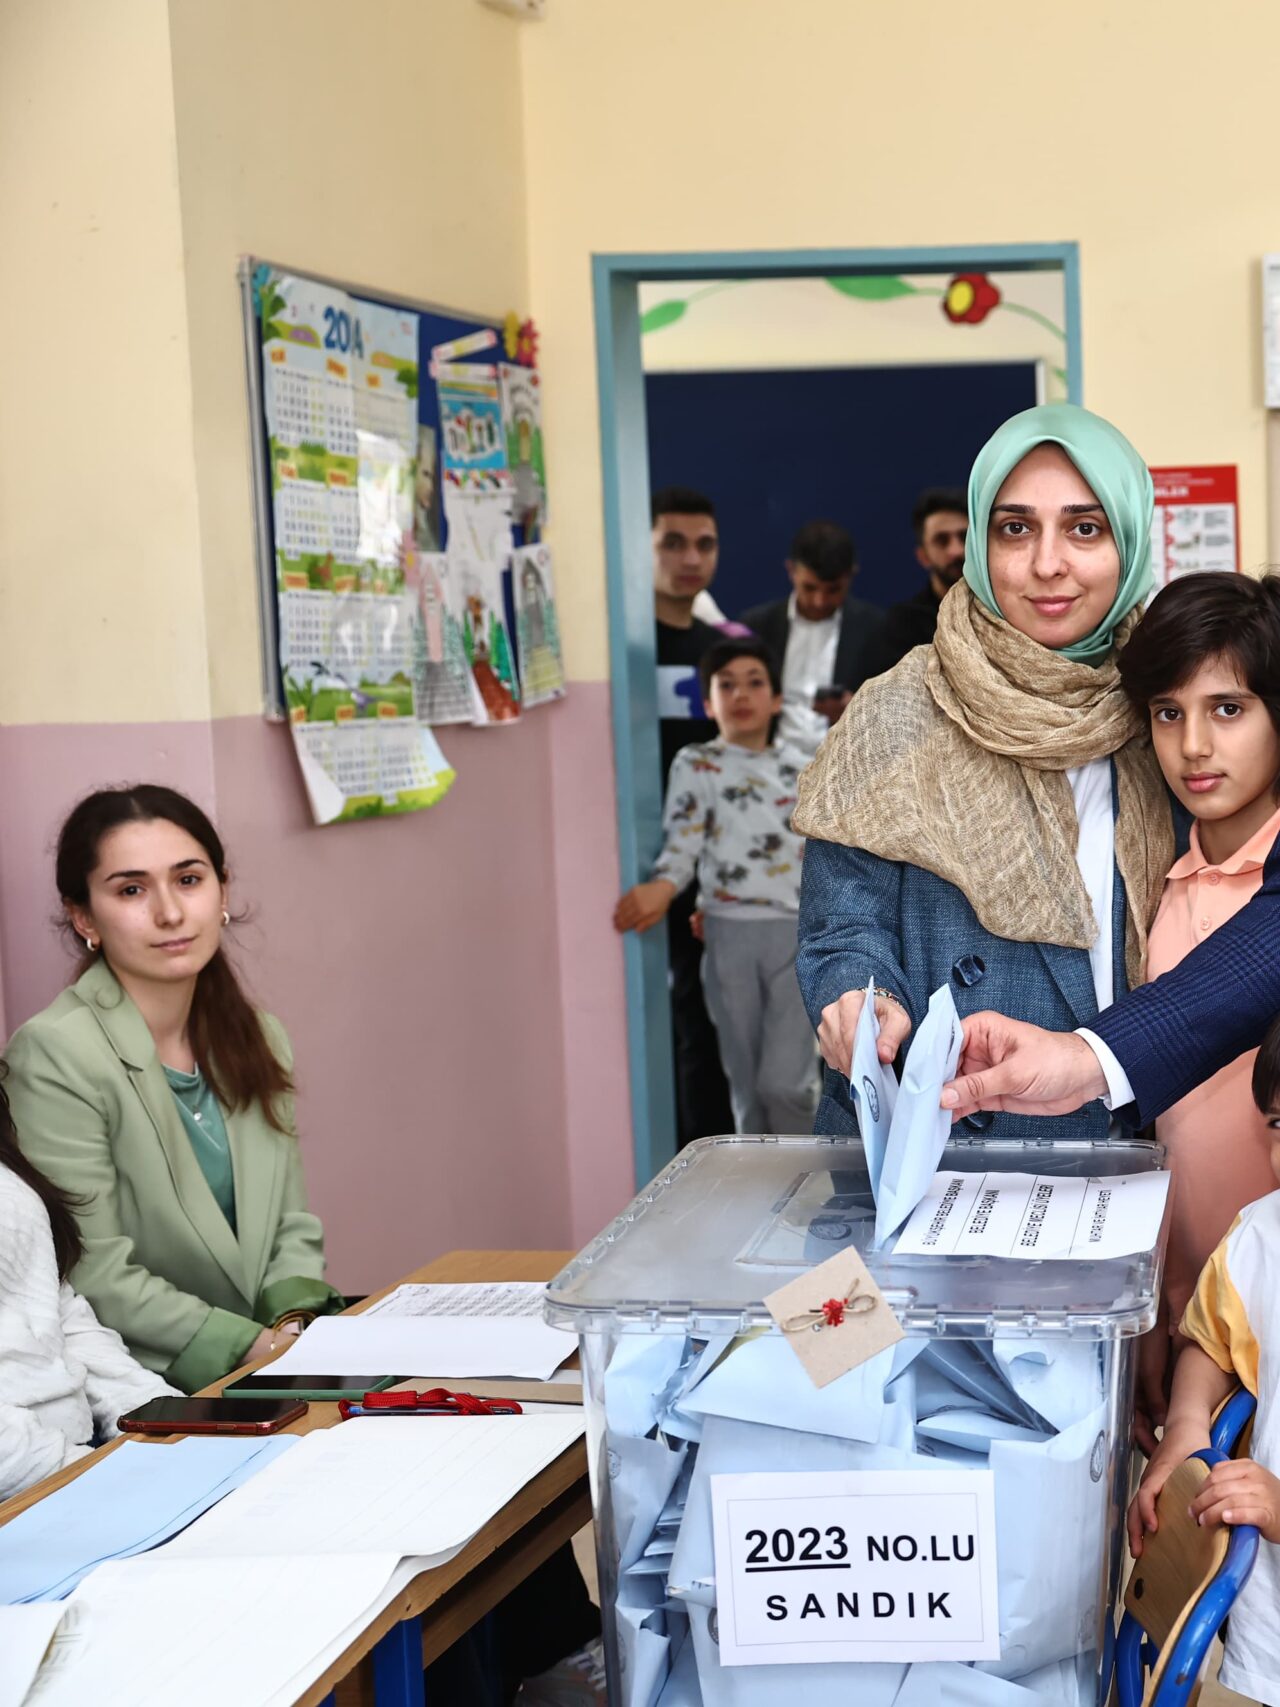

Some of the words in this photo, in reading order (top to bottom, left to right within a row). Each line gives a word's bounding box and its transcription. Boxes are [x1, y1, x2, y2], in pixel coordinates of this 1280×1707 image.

[945, 1178, 965, 1196] BAŞKANI
[978, 1189, 1001, 1209] BAŞKANI
[936, 1196, 956, 1216] BELEDİYE
[968, 1209, 992, 1233] BELEDİYE
[1020, 1222, 1043, 1247] BELEDİYE
[745, 1526, 849, 1564] 2023
[867, 1534, 975, 1562] NO.LU
[766, 1592, 952, 1621] SANDIK
